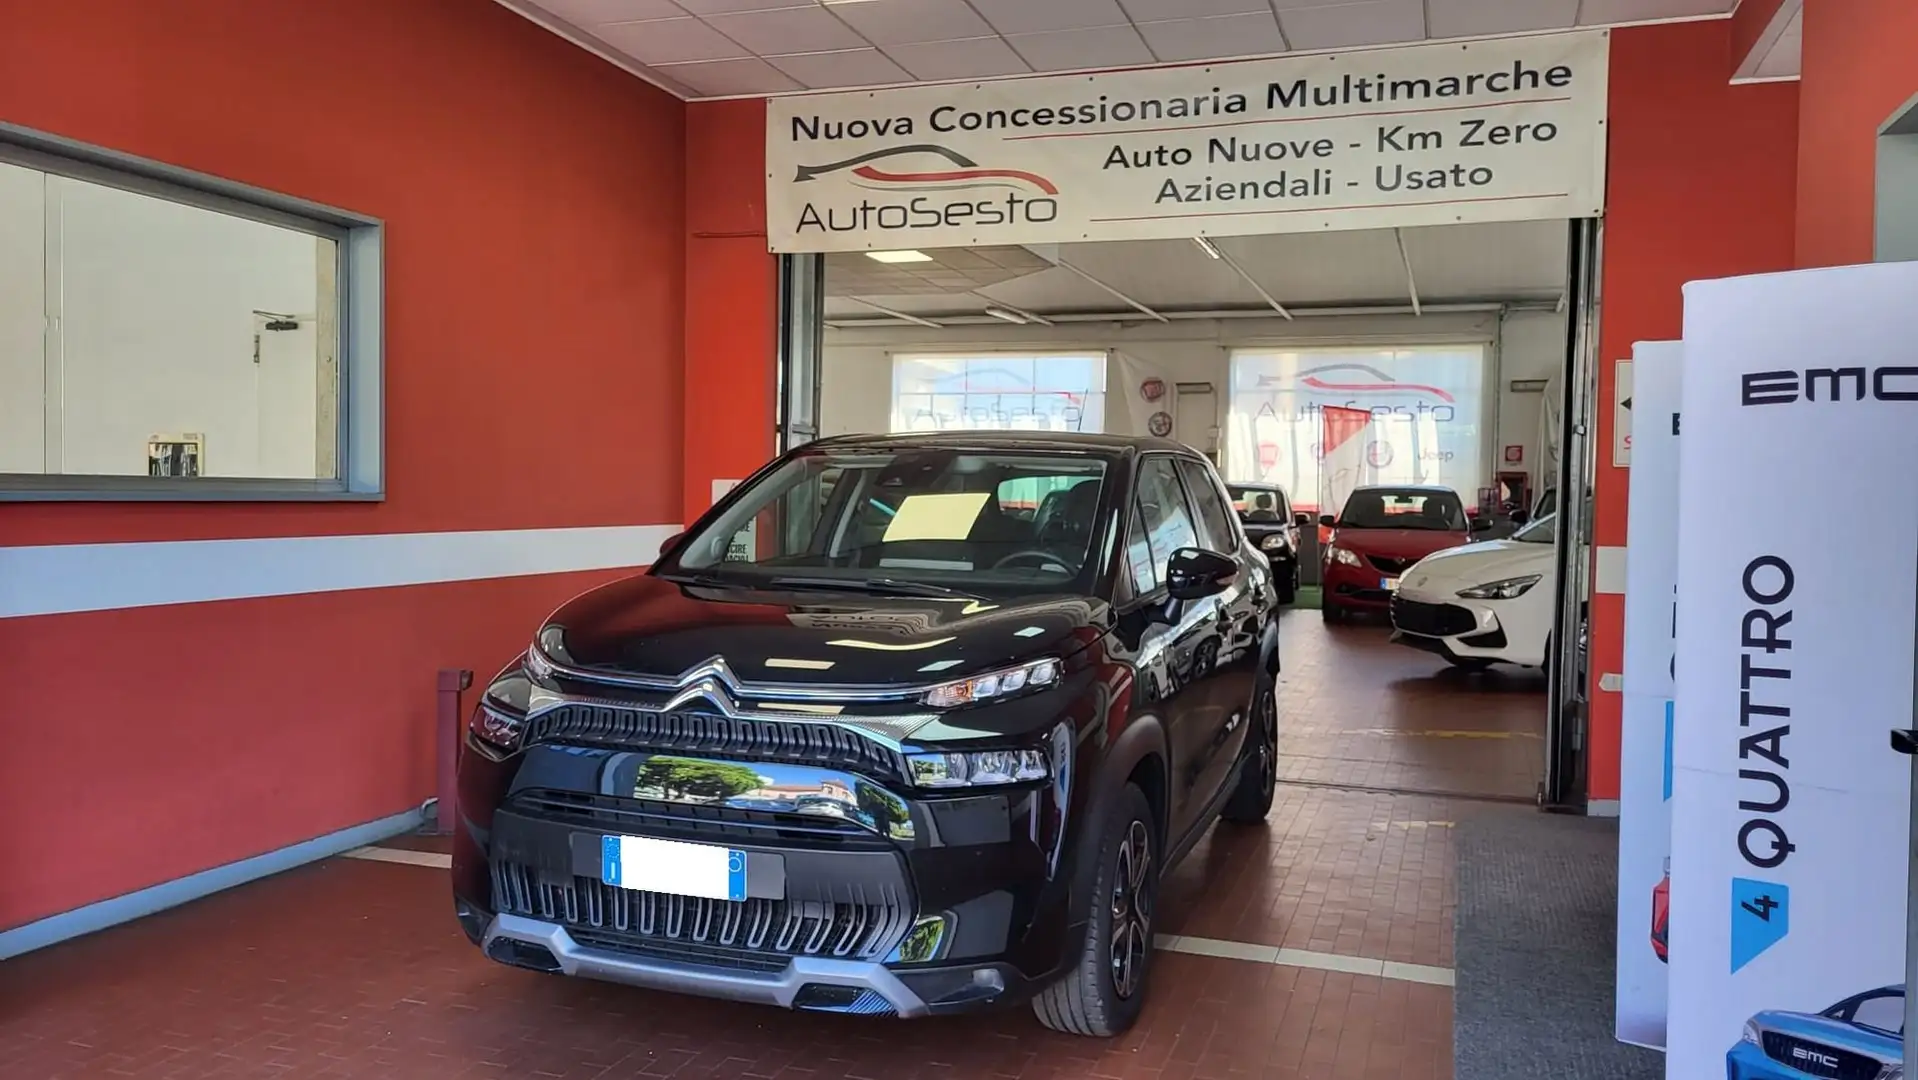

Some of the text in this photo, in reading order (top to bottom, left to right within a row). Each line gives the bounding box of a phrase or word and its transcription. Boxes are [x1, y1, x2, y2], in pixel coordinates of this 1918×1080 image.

[792, 59, 1572, 142] Nuova Concessionaria Multimarche
[1103, 144, 1193, 170] Auto
[1209, 136, 1334, 164] Nuove
[1378, 126, 1442, 153] Km
[1459, 120, 1557, 147] Zero
[1155, 168, 1331, 204] Aziendali
[1375, 163, 1493, 192] Usato
[796, 192, 1057, 234] AutoSesto
[1737, 555, 1796, 925] 4 QUATTRO
